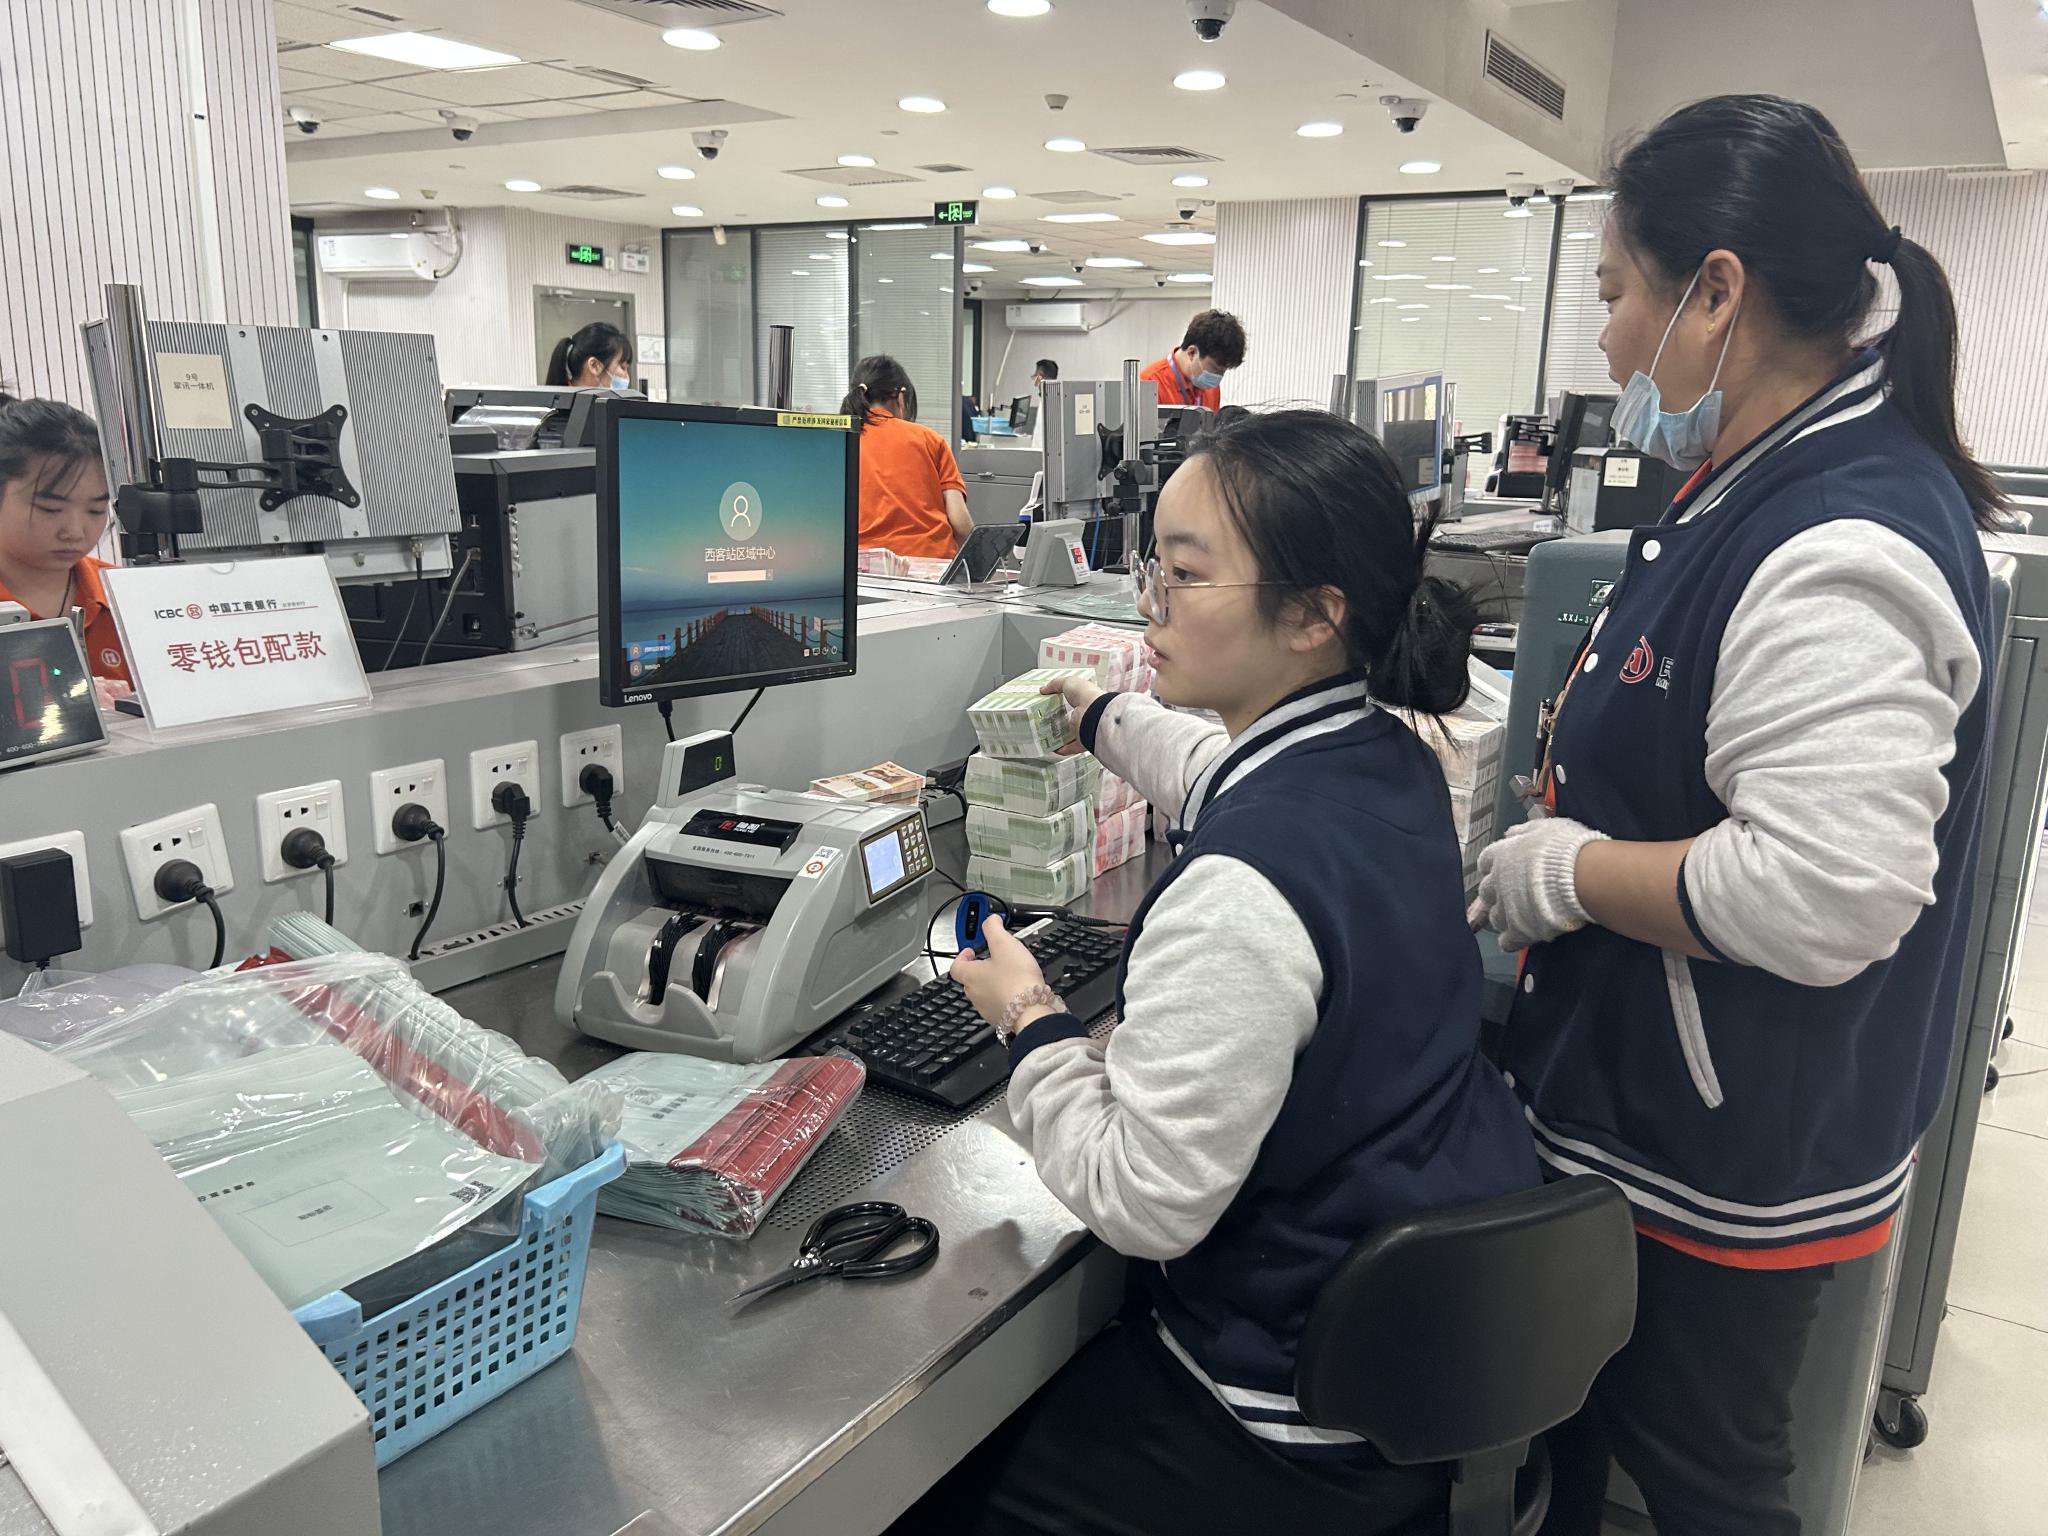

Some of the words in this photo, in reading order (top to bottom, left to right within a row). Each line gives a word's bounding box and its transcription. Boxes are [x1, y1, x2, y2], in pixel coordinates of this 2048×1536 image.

[704, 546, 776, 562] 西客站区域中心
[154, 608, 184, 620] ICBC
[208, 599, 278, 614] 中国工商银行
[167, 631, 327, 673] 零钱包配款
[624, 693, 653, 703] Lenovo
[715, 756, 722, 771] 0
